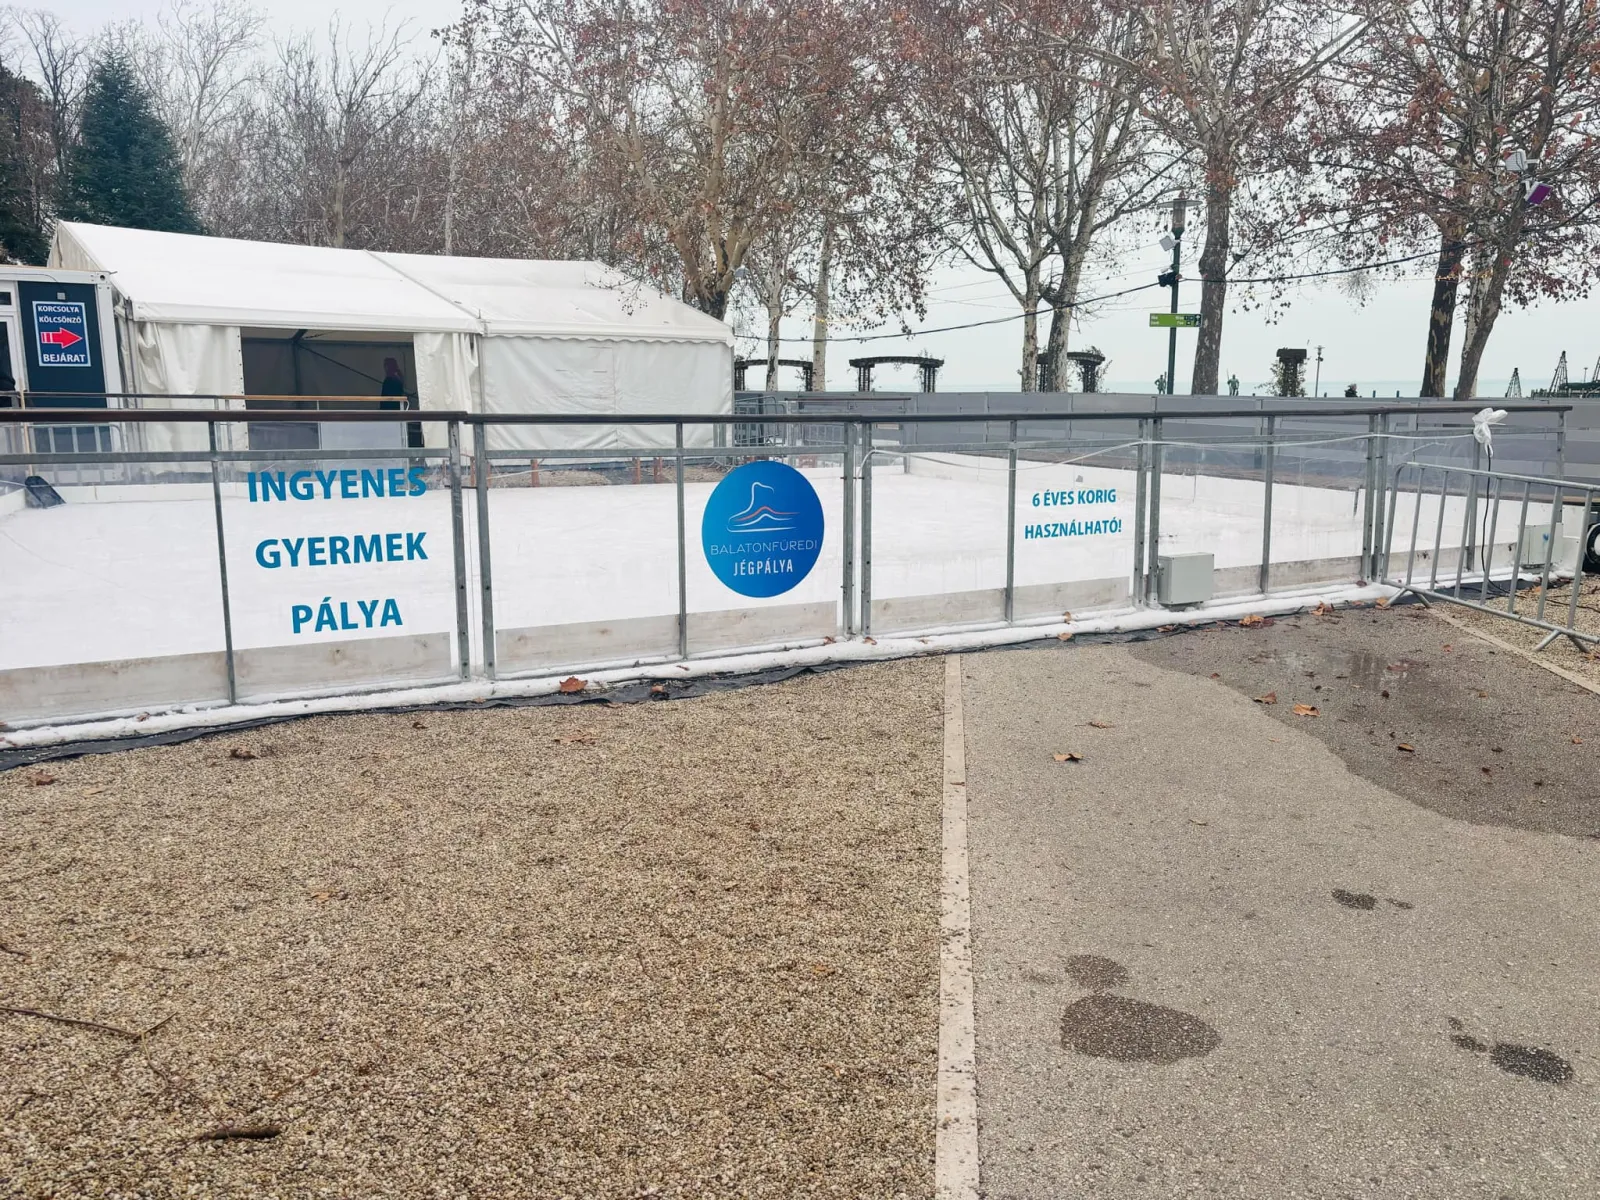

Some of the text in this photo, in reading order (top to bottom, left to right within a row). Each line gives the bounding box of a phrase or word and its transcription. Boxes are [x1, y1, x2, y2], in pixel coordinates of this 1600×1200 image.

[37, 305, 80, 313] KORCSOLYA
[42, 352, 86, 363] BEJÁRAT
[247, 467, 427, 502] INGYENES
[1032, 489, 1116, 507] 6 ÉVES KORIG
[1024, 516, 1122, 539] HASZNÁLHATÓ!
[255, 532, 429, 569] GYERMEK
[710, 539, 818, 556] BALATONFÜREDI
[733, 557, 794, 576] JÉGPÁLYA
[291, 596, 403, 634] PÁLYA
